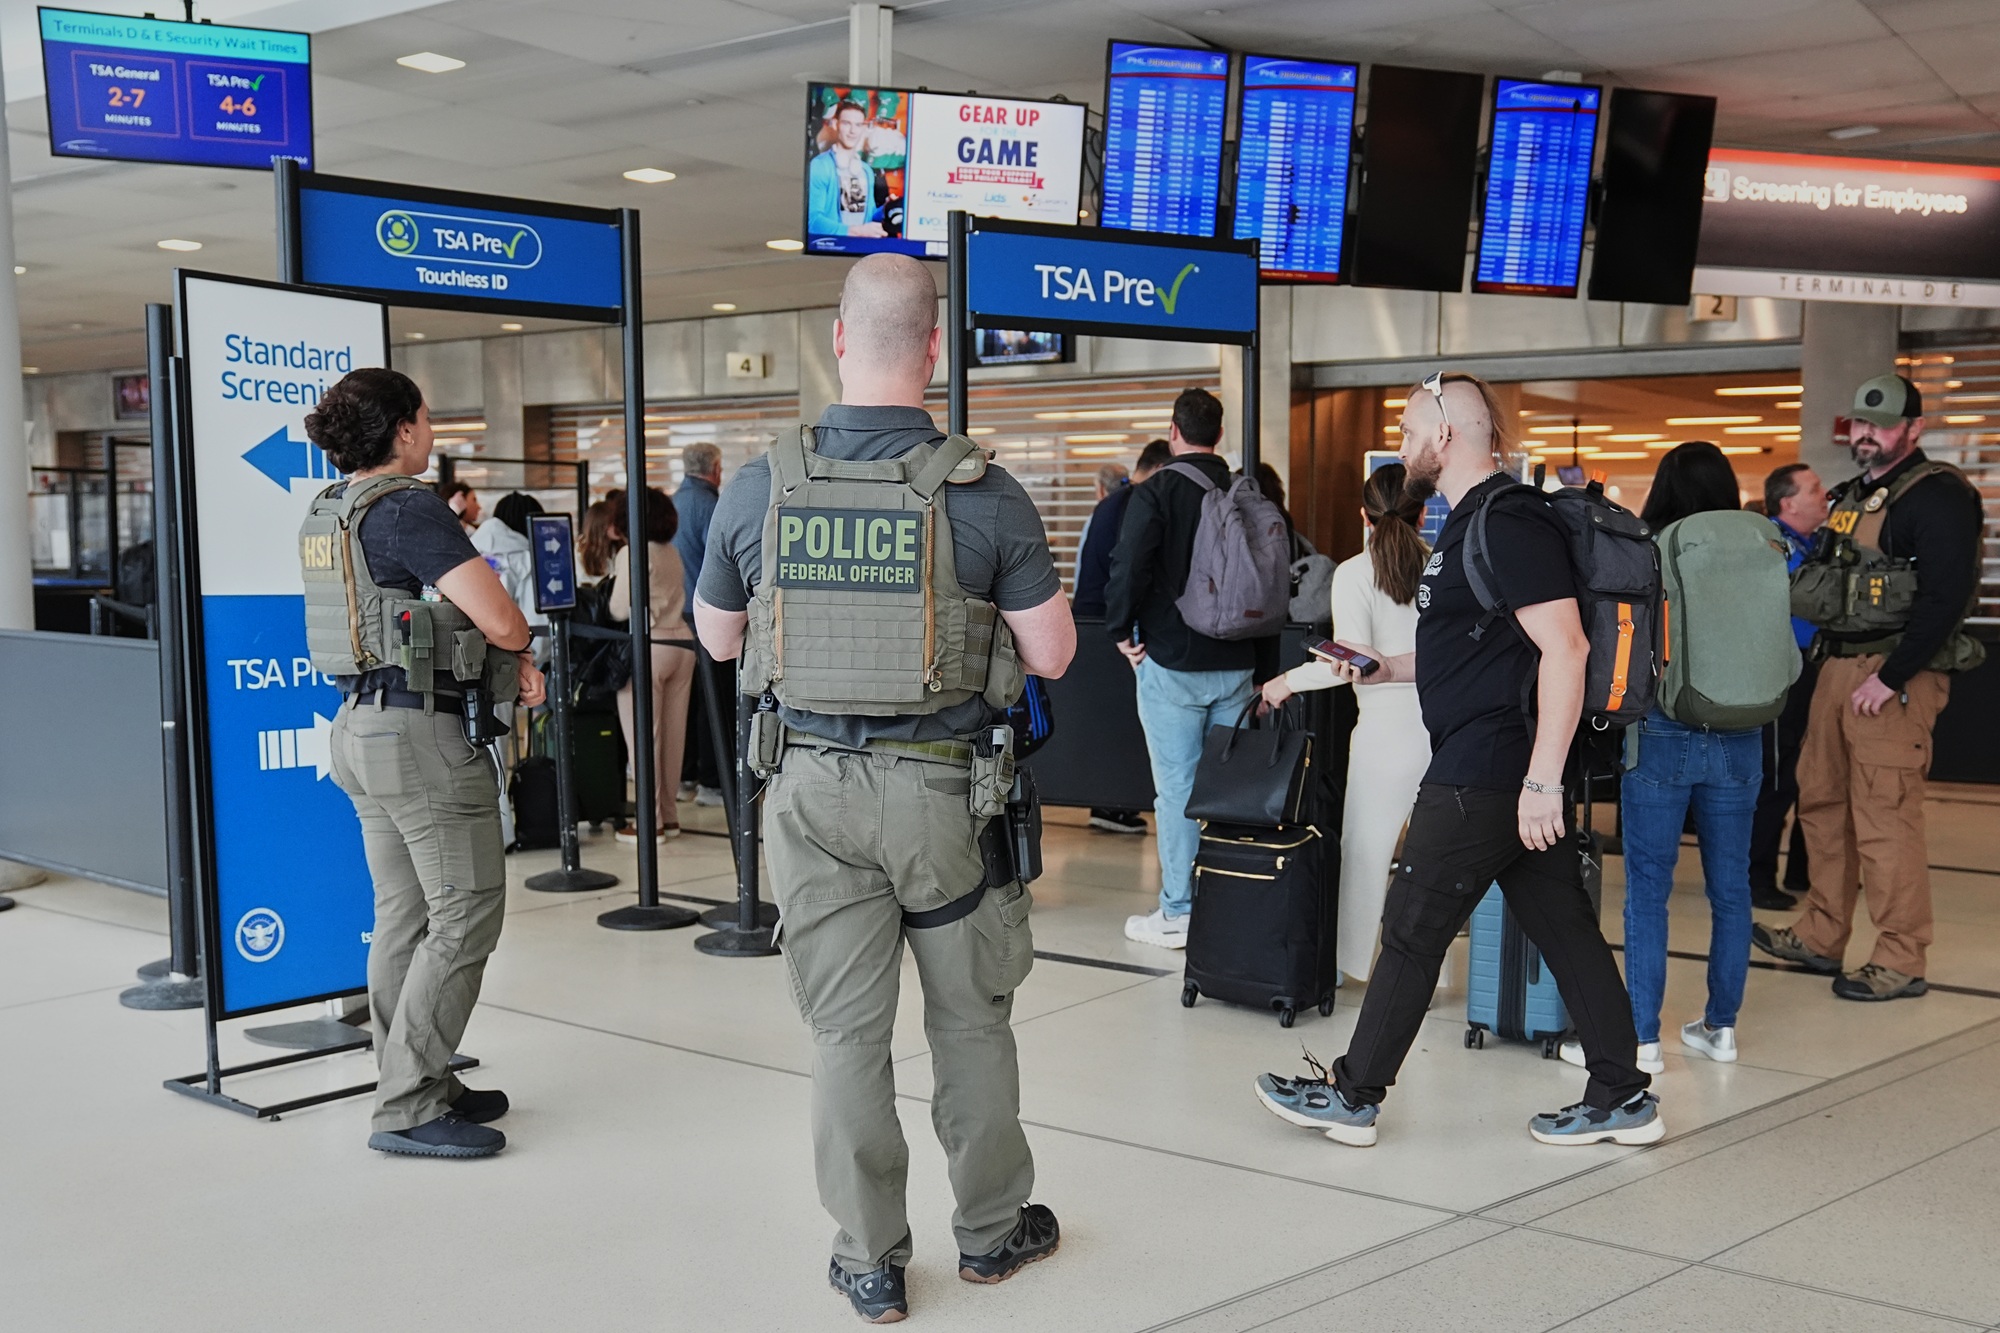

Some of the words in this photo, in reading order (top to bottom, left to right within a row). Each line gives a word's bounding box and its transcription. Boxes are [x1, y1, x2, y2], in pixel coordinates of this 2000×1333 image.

[54, 19, 122, 38] Terminals
[126, 28, 137, 38] D
[141, 29, 150, 40] &
[155, 30, 162, 41] E
[167, 32, 219, 48] Security
[225, 38, 255, 50] Wait
[260, 40, 297, 54] Times
[89, 64, 115, 77] TSA
[115, 67, 160, 82] General
[207, 74, 231, 87] TSA
[231, 77, 250, 89] Pre
[108, 86, 145, 108] 2-7
[219, 95, 257, 116] 4-6
[105, 114, 152, 126] MINUTES
[960, 104, 1007, 124] GEAR
[1016, 108, 1040, 126] UP
[216, 122, 261, 134] MINUTES
[980, 126, 998, 136] FOR
[1002, 128, 1018, 137] THE
[957, 136, 1038, 167] GAME
[984, 192, 1006, 203] Lids
[1733, 176, 1831, 210] Screening
[1834, 183, 1862, 207] for
[1864, 185, 1968, 216] Employees
[433, 228, 469, 250] TSA
[472, 232, 502, 254] Pre
[416, 266, 489, 288] Touchless
[492, 274, 508, 290] ID
[1034, 264, 1096, 302] TSA
[1104, 270, 1155, 306] Pre
[1779, 276, 1907, 296] TERMINAL
[1924, 283, 1934, 298] D
[1950, 284, 1959, 298] E
[1712, 296, 1722, 315] 2
[225, 333, 351, 373] Standard
[741, 358, 751, 373] 4
[221, 370, 332, 406] Screeni
[1828, 511, 1859, 534] HSI
[780, 516, 916, 561] POLICE
[305, 536, 331, 568] HSI
[780, 563, 845, 581] FEDERAL
[850, 565, 914, 584] OFFICER
[227, 658, 286, 690] TSA
